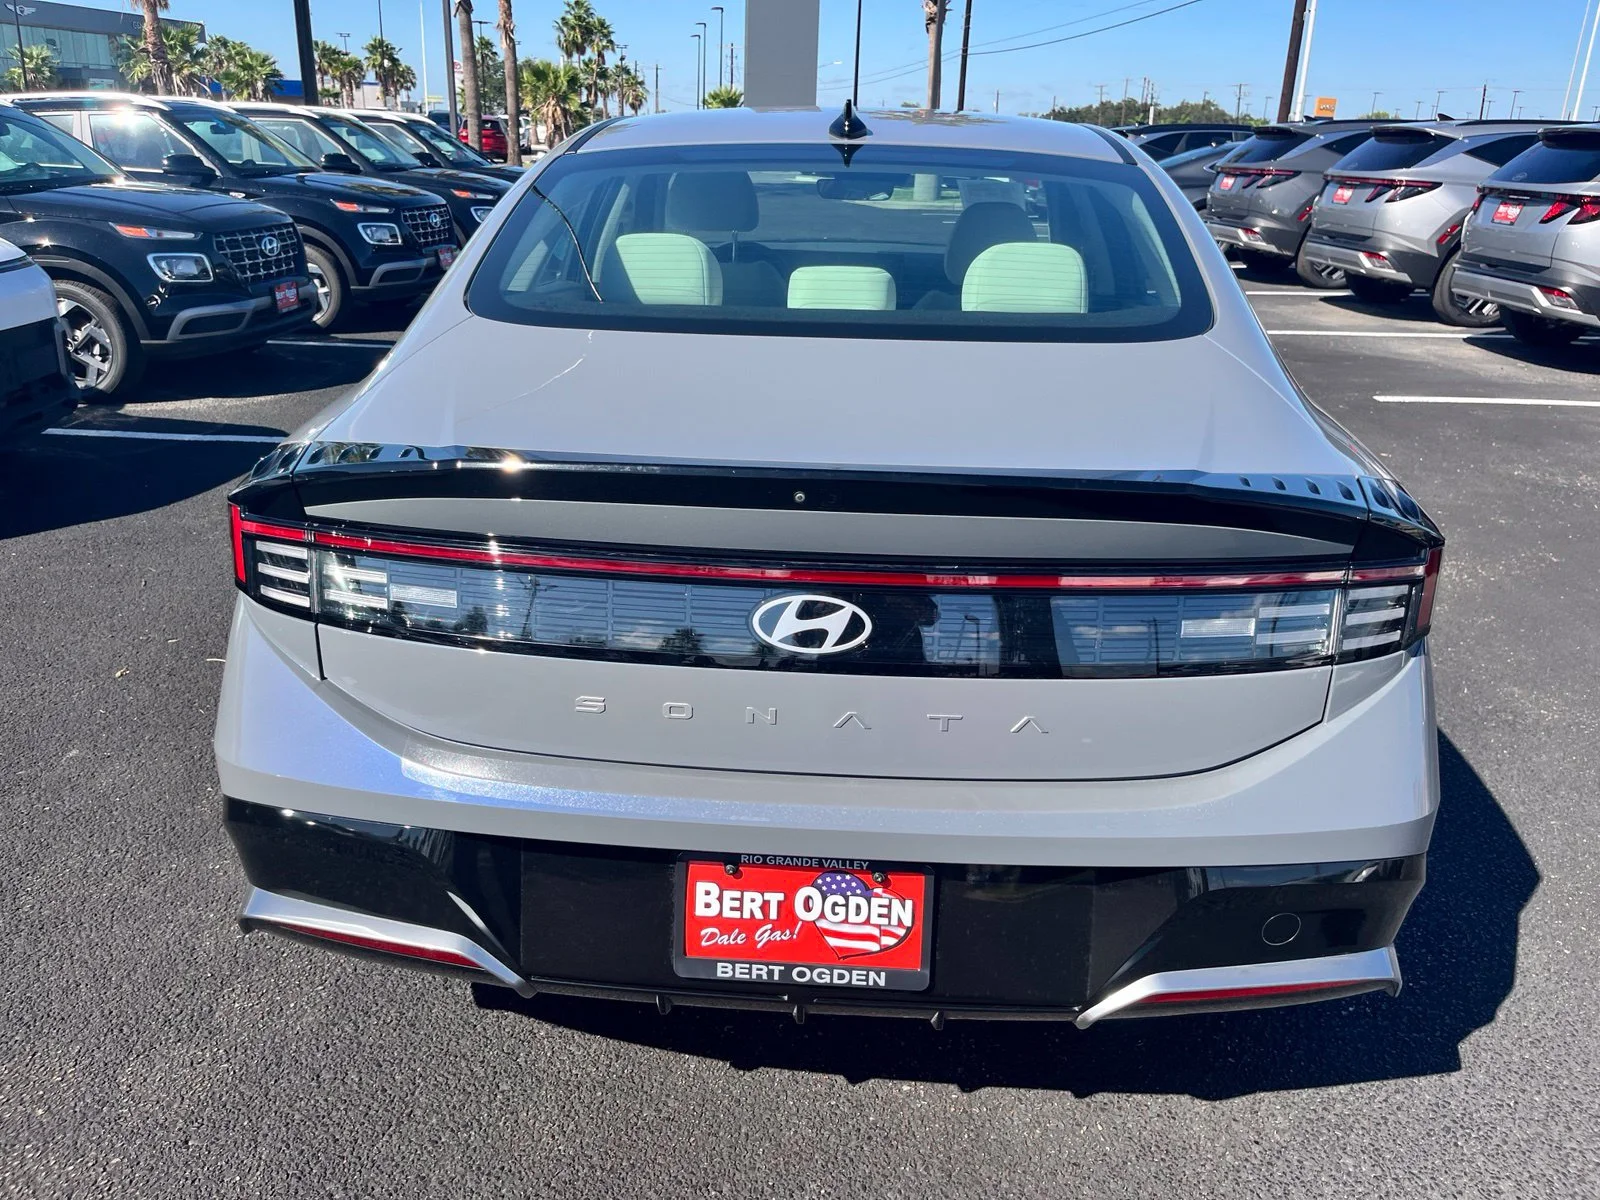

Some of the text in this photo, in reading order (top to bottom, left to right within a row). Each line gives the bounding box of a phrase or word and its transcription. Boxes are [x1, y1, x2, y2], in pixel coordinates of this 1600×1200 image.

[575, 695, 1049, 735] SONATA
[740, 854, 869, 870] RIO GRANDE VALLEY
[694, 881, 913, 927] BERT OGDEN
[700, 921, 803, 948] Dale Gas!
[716, 962, 886, 987] BERT OGDEN
